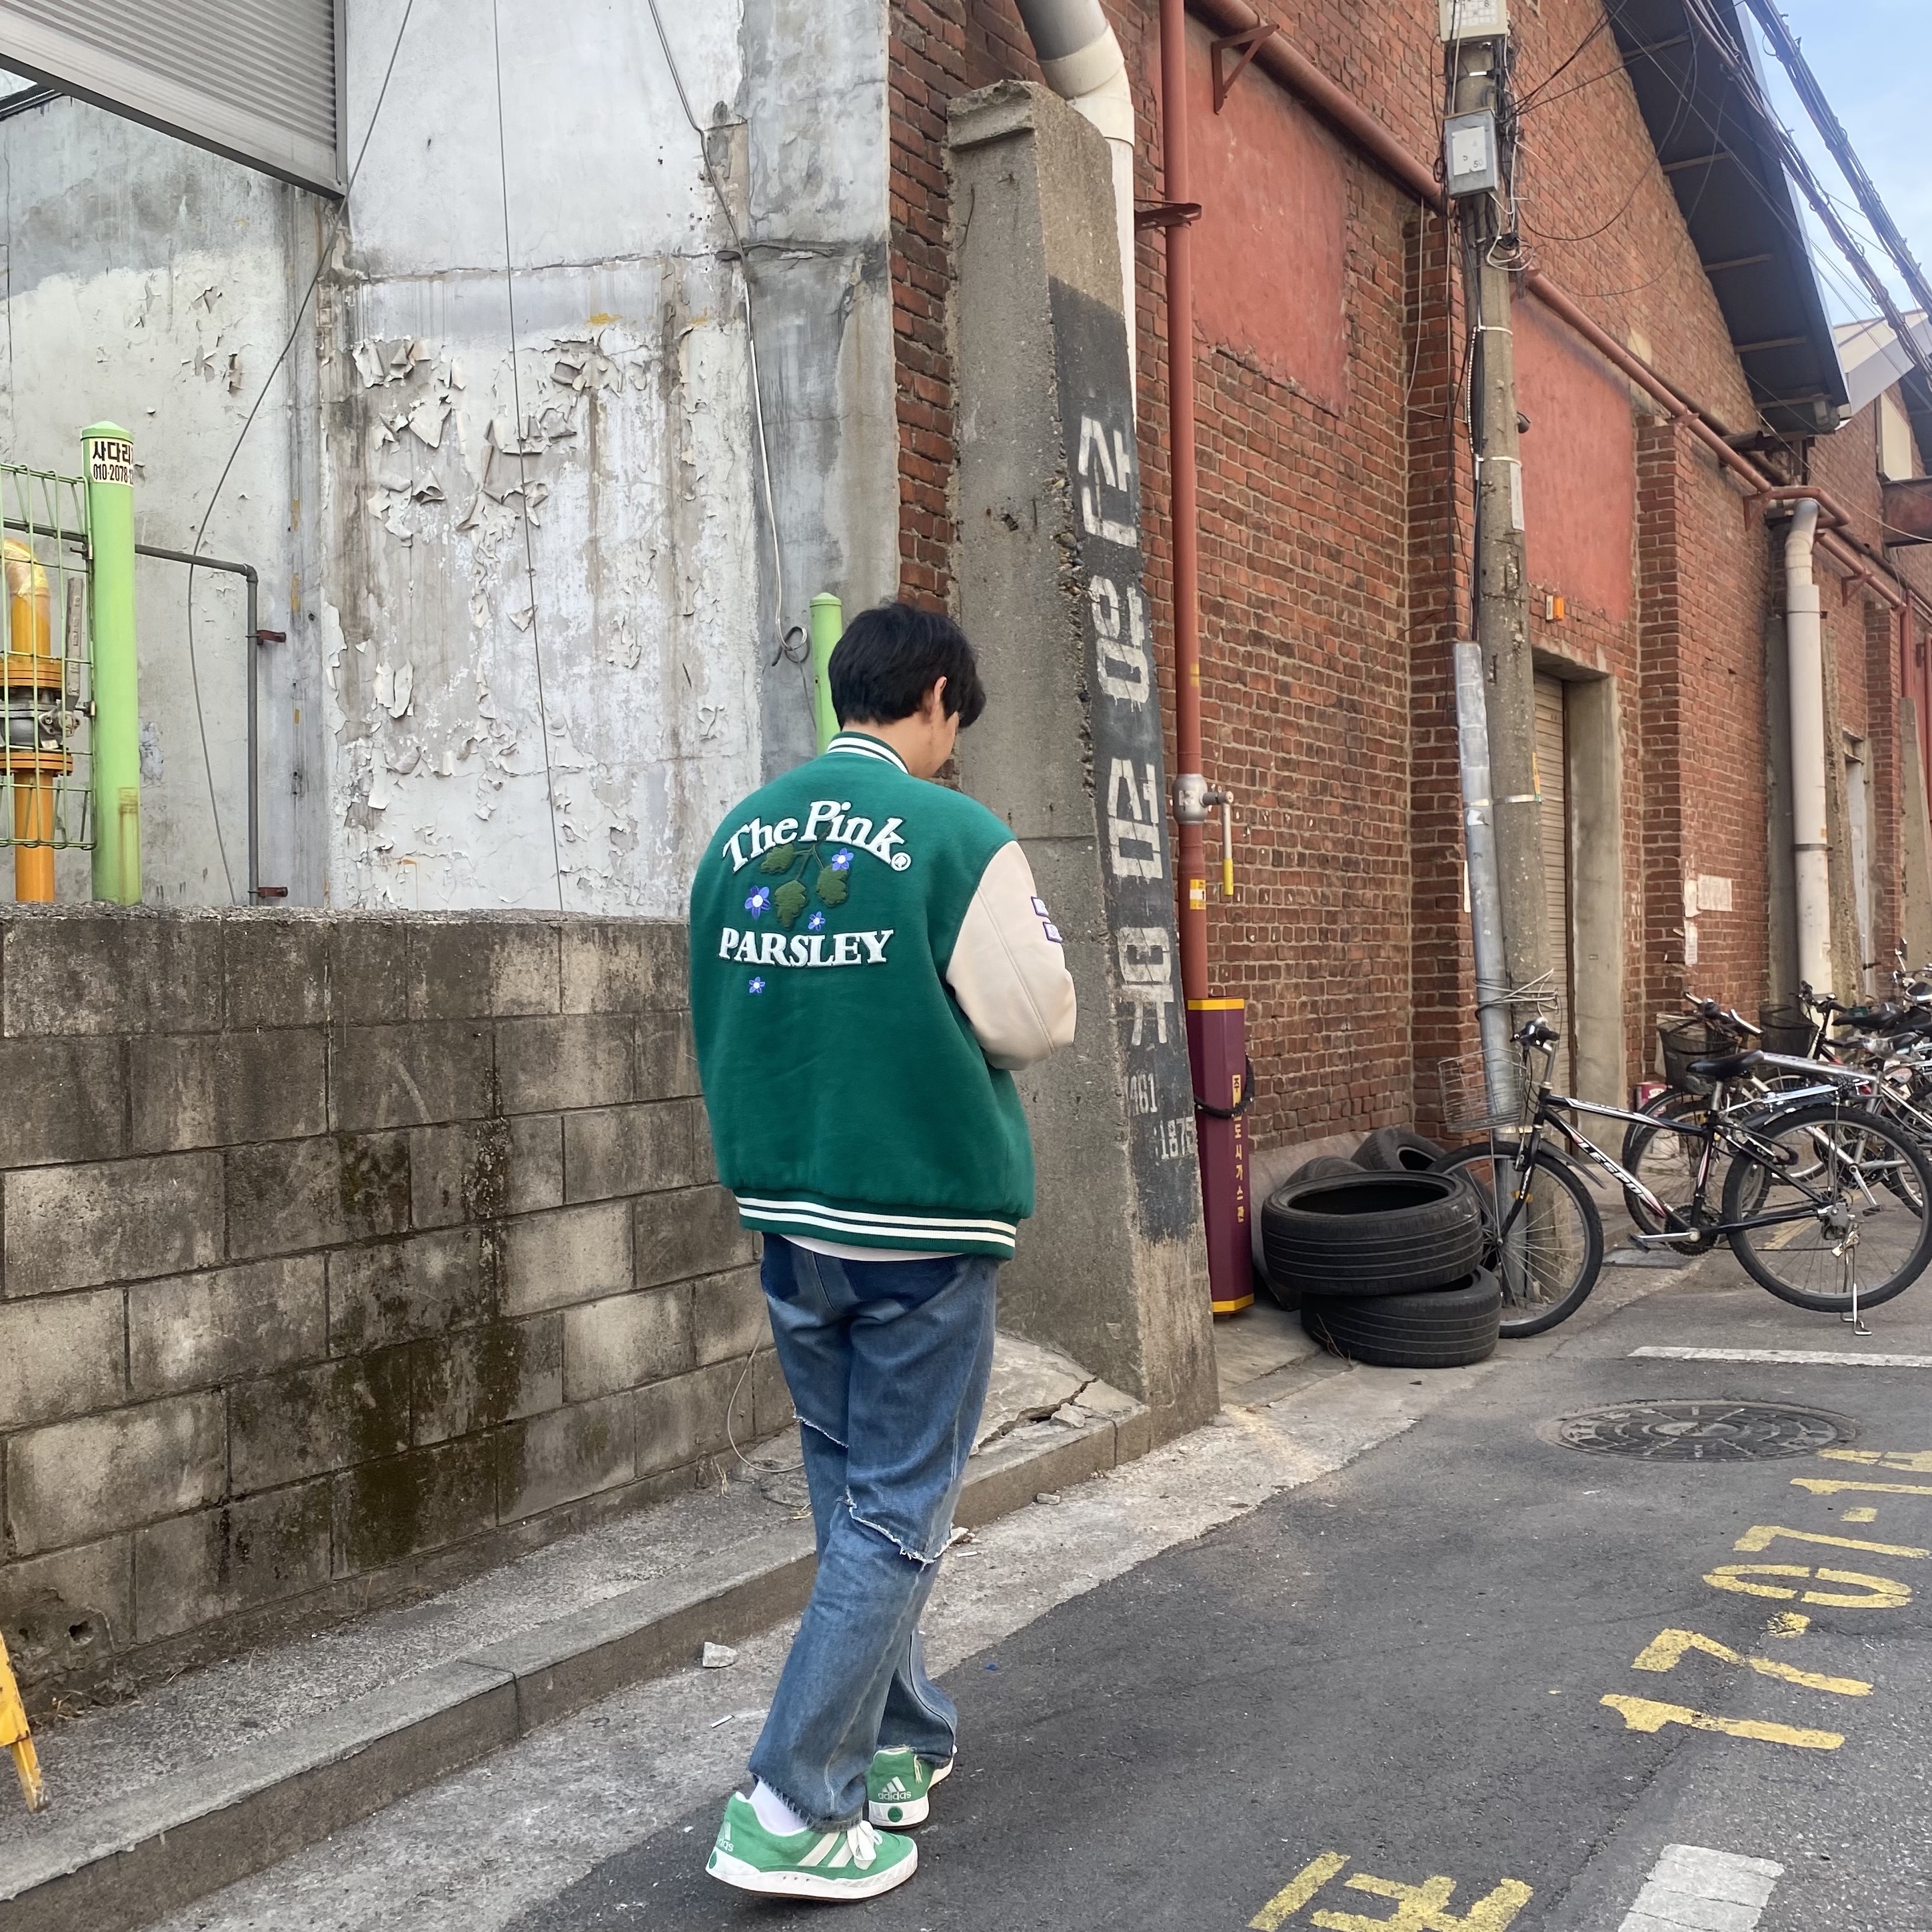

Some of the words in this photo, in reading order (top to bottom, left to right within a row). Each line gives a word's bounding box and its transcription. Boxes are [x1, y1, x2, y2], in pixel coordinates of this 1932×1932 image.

[92, 441, 133, 465] 사다리
[722, 816, 799, 874] The
[718, 927, 894, 966] PARSLEY
[878, 1791, 911, 1801] adidas
